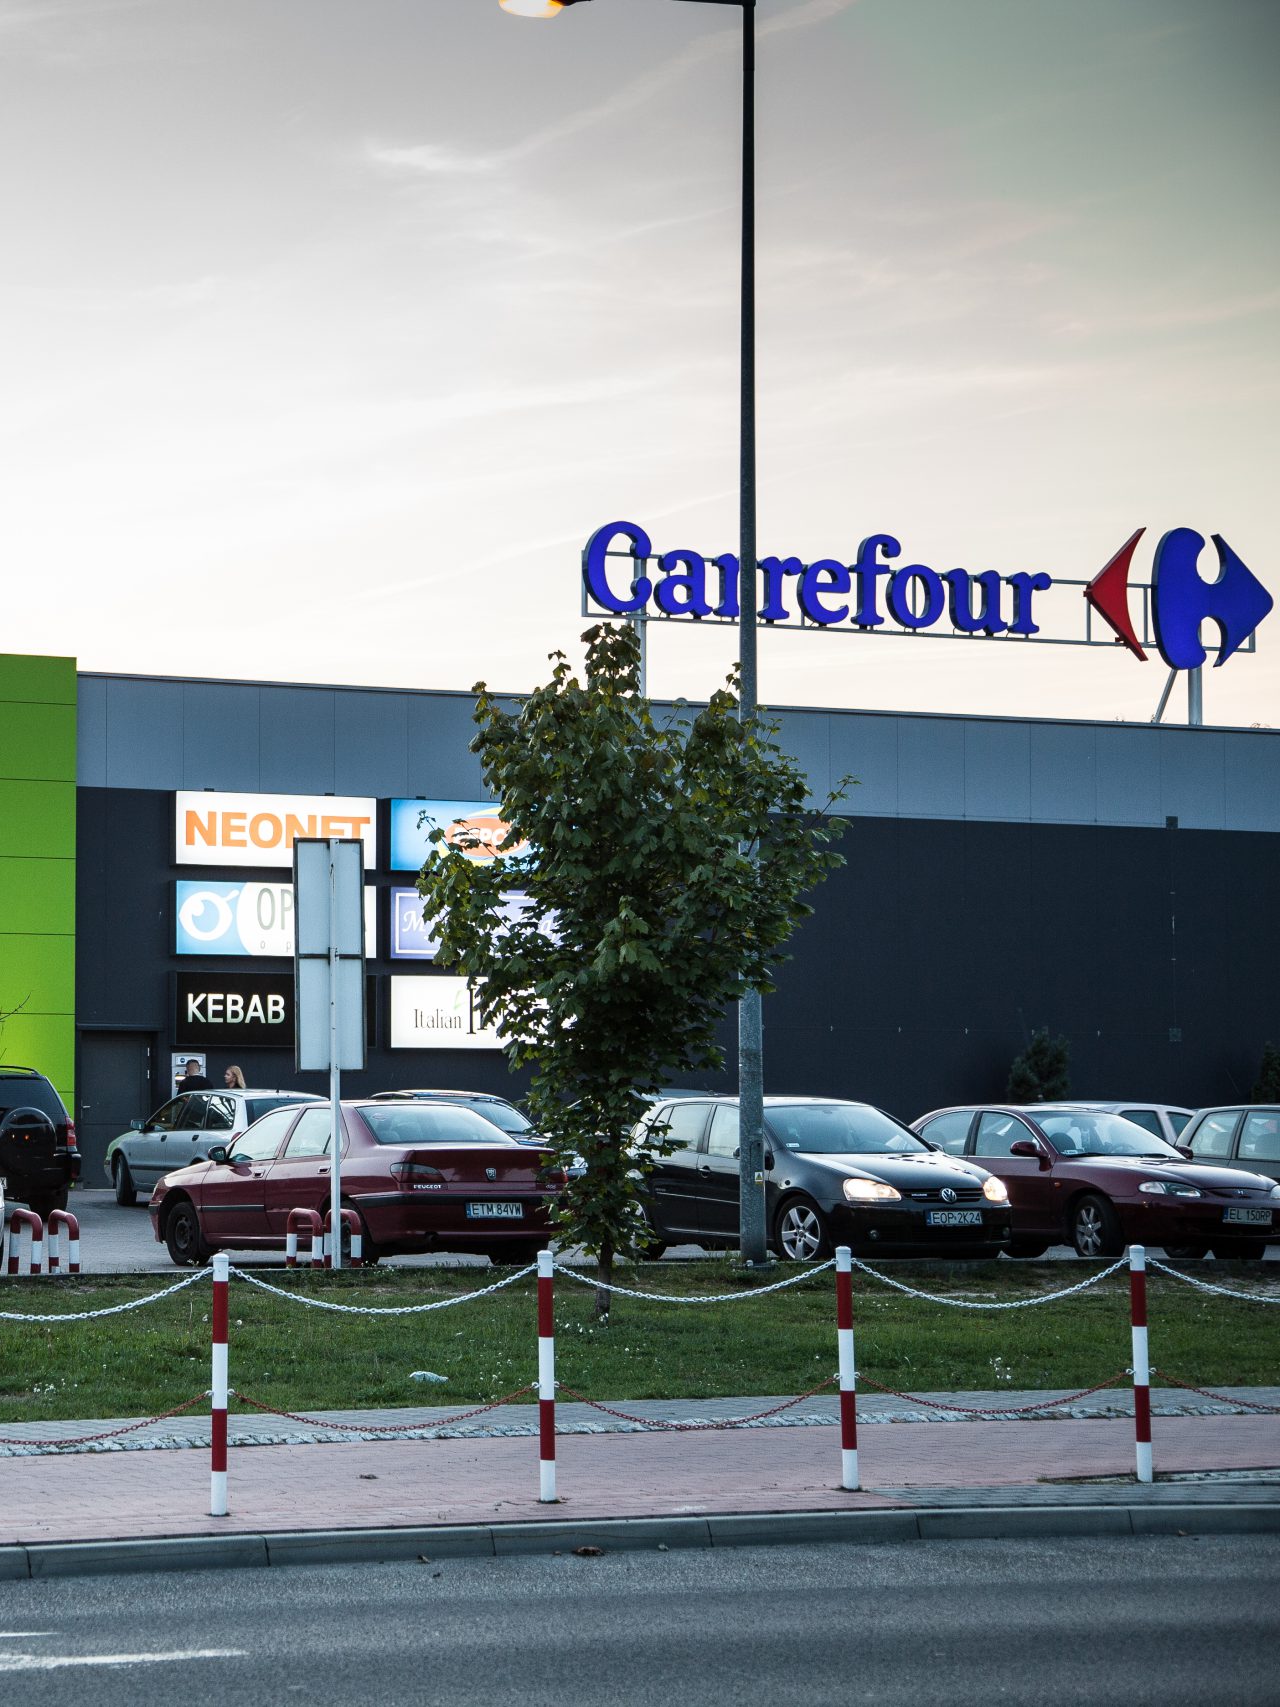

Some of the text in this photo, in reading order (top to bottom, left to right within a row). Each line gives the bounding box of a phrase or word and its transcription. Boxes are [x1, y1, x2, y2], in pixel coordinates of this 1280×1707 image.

[583, 520, 1052, 636] Carrefour
[185, 810, 371, 849] NEONET
[187, 993, 286, 1024] KEBAB
[414, 1008, 462, 1029] Italian
[472, 1203, 521, 1216] ETM 84VW
[932, 1212, 981, 1225] EOP 2K24
[1229, 1208, 1242, 1221] EL
